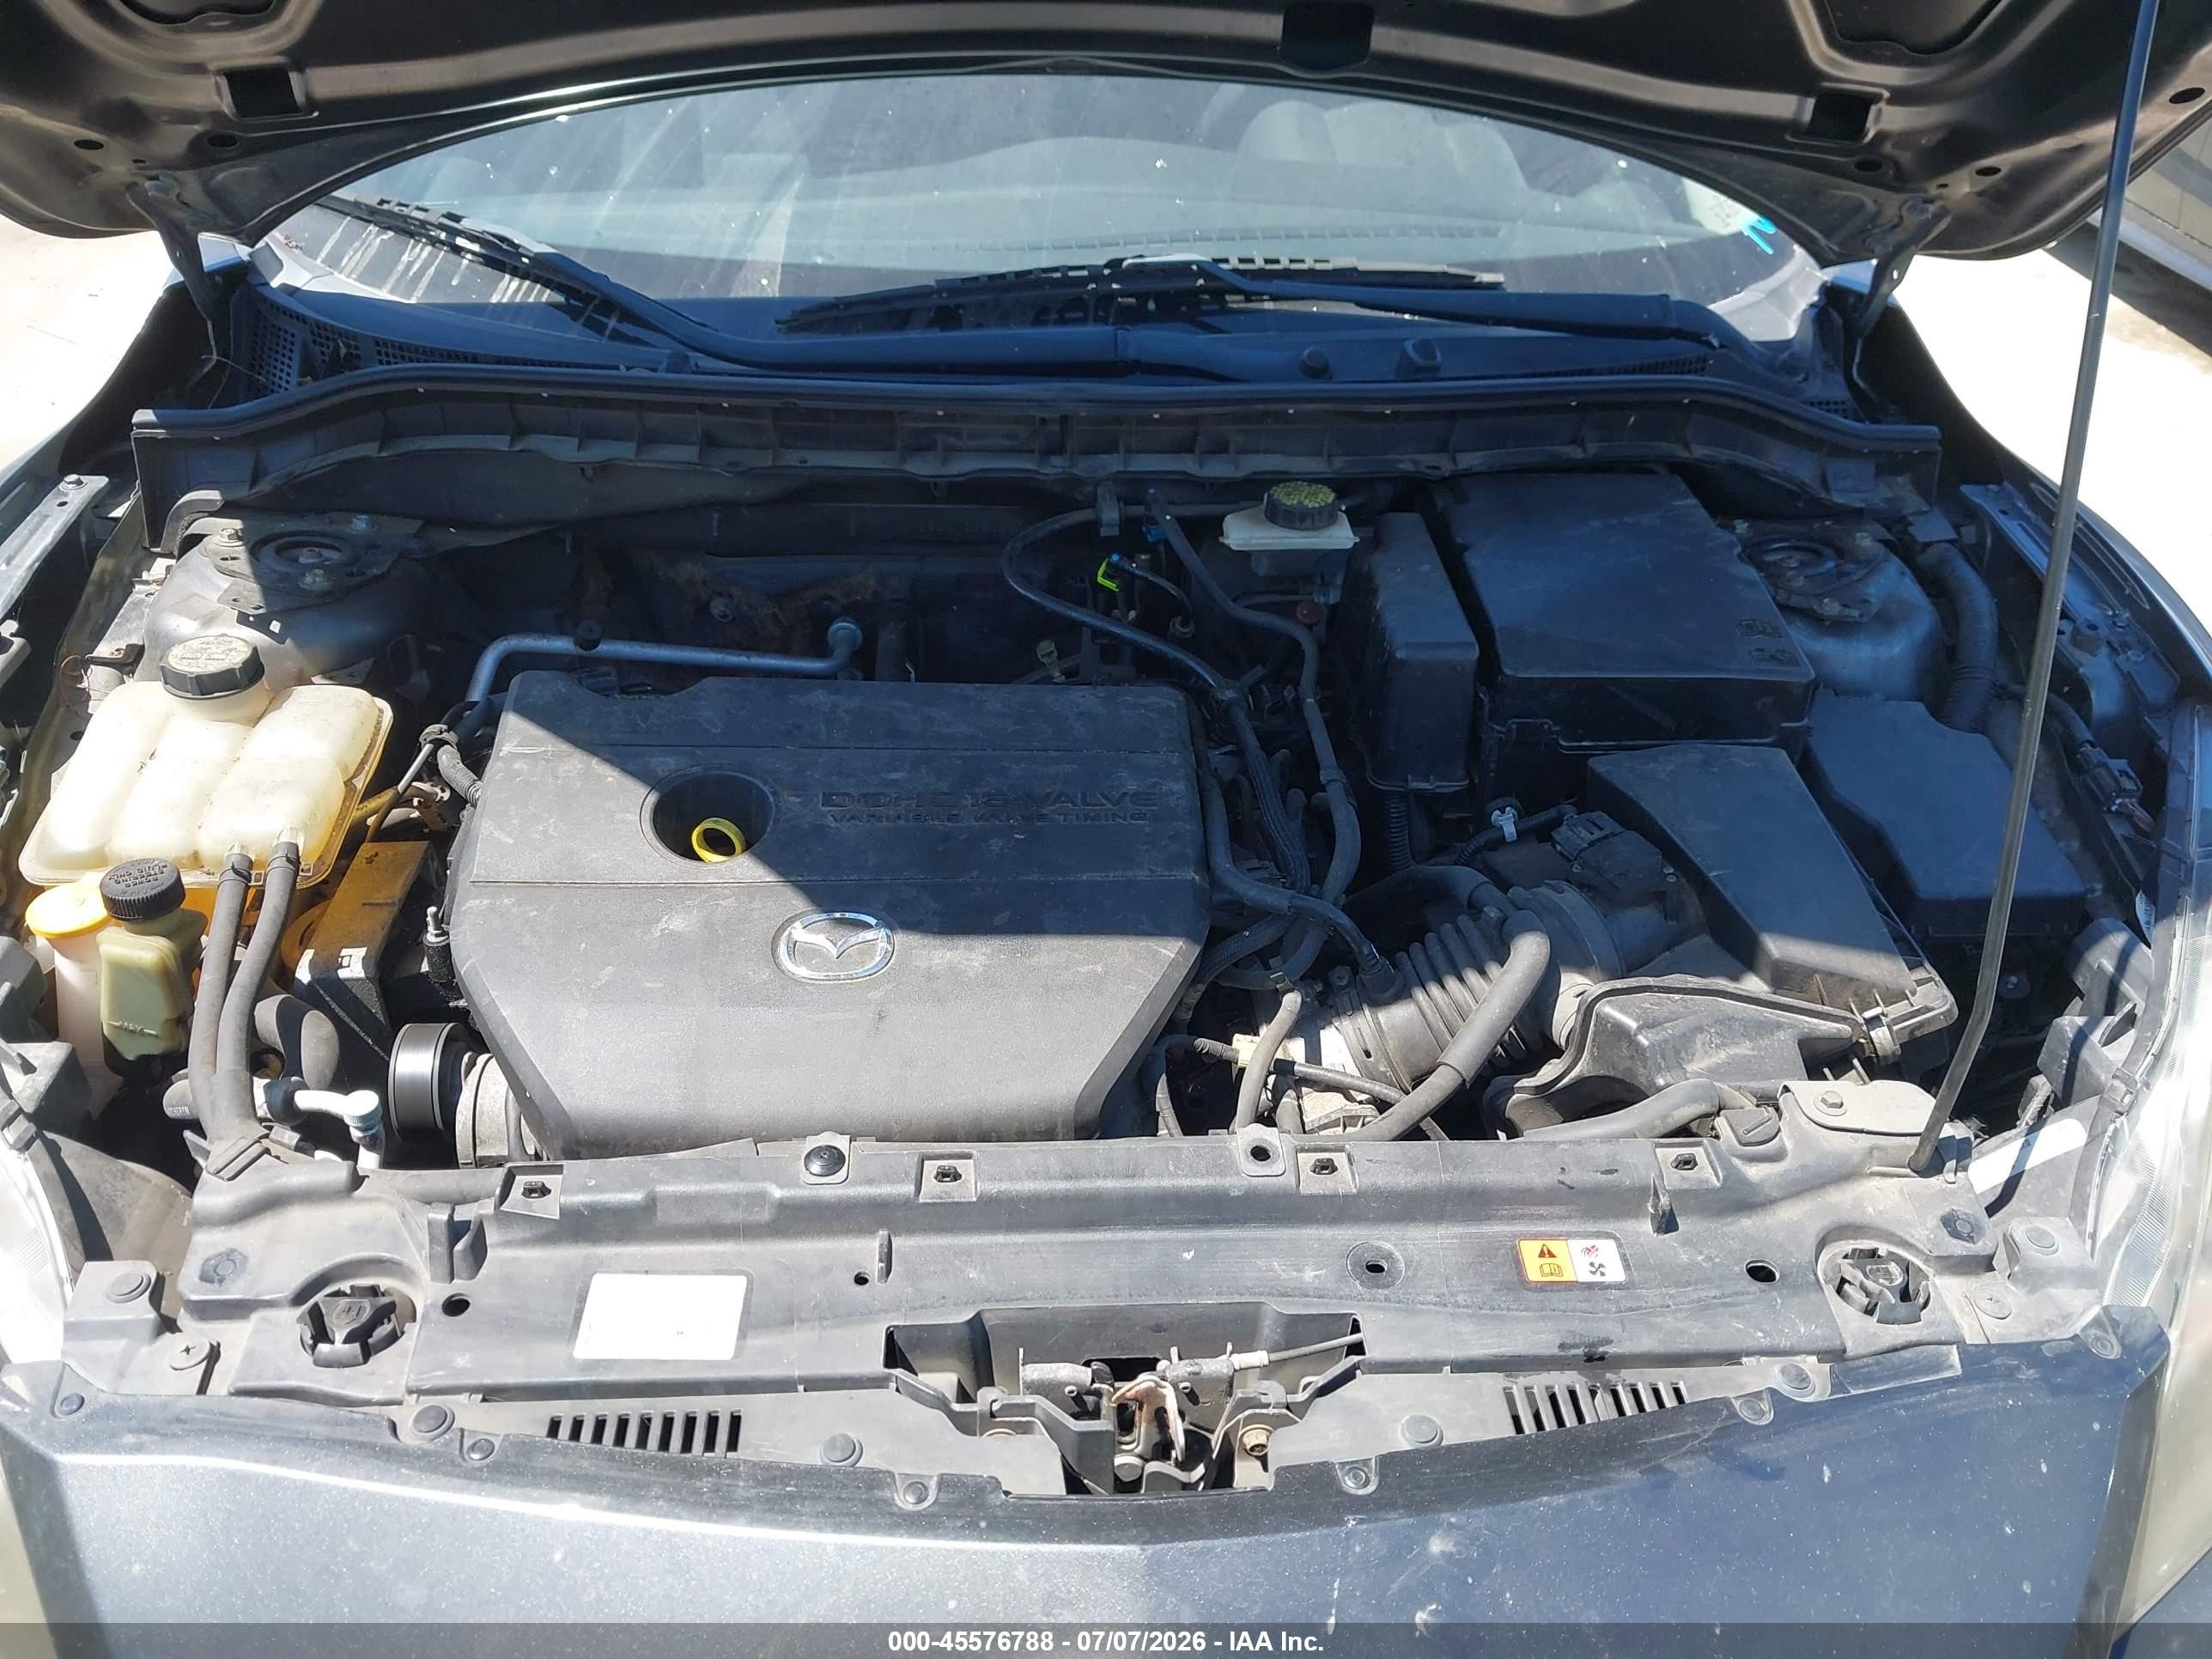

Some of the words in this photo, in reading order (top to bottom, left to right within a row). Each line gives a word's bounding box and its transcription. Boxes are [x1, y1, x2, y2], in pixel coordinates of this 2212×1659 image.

[820, 791, 957, 809] DOHC
[1055, 811, 1149, 824] TIMING
[136, 863, 168, 874] FLUID
[107, 870, 133, 882] ONLY
[113, 868, 165, 885] STEERING
[124, 877, 159, 888] POWER
